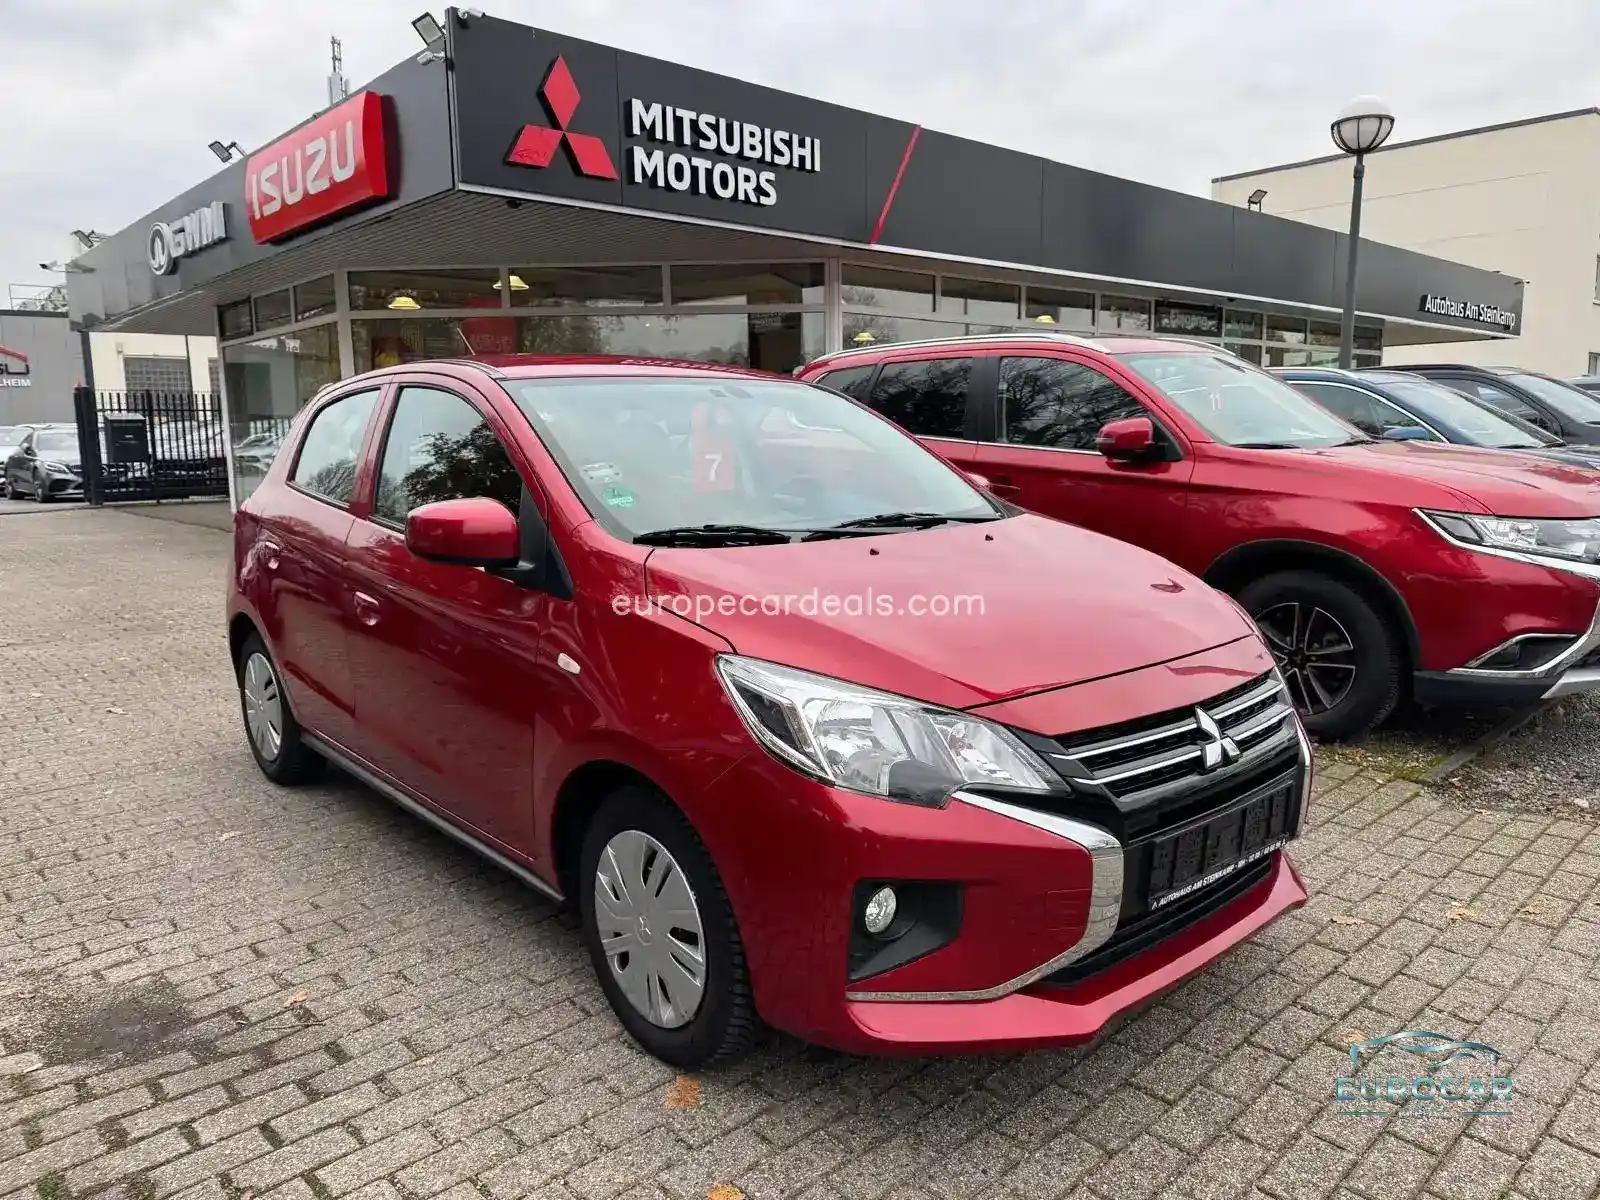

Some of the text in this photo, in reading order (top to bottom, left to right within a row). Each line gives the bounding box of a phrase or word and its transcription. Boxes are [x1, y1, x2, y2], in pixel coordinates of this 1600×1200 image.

[631, 97, 821, 172] MITSUBISHI
[251, 119, 356, 221] ISUZU
[633, 145, 777, 206] MOTORS
[169, 200, 226, 258] GWM
[1424, 294, 1517, 330] Autohaus Am Steinkamp
[704, 453, 722, 482] 7
[1158, 885, 1192, 907] AUTOHAUS
